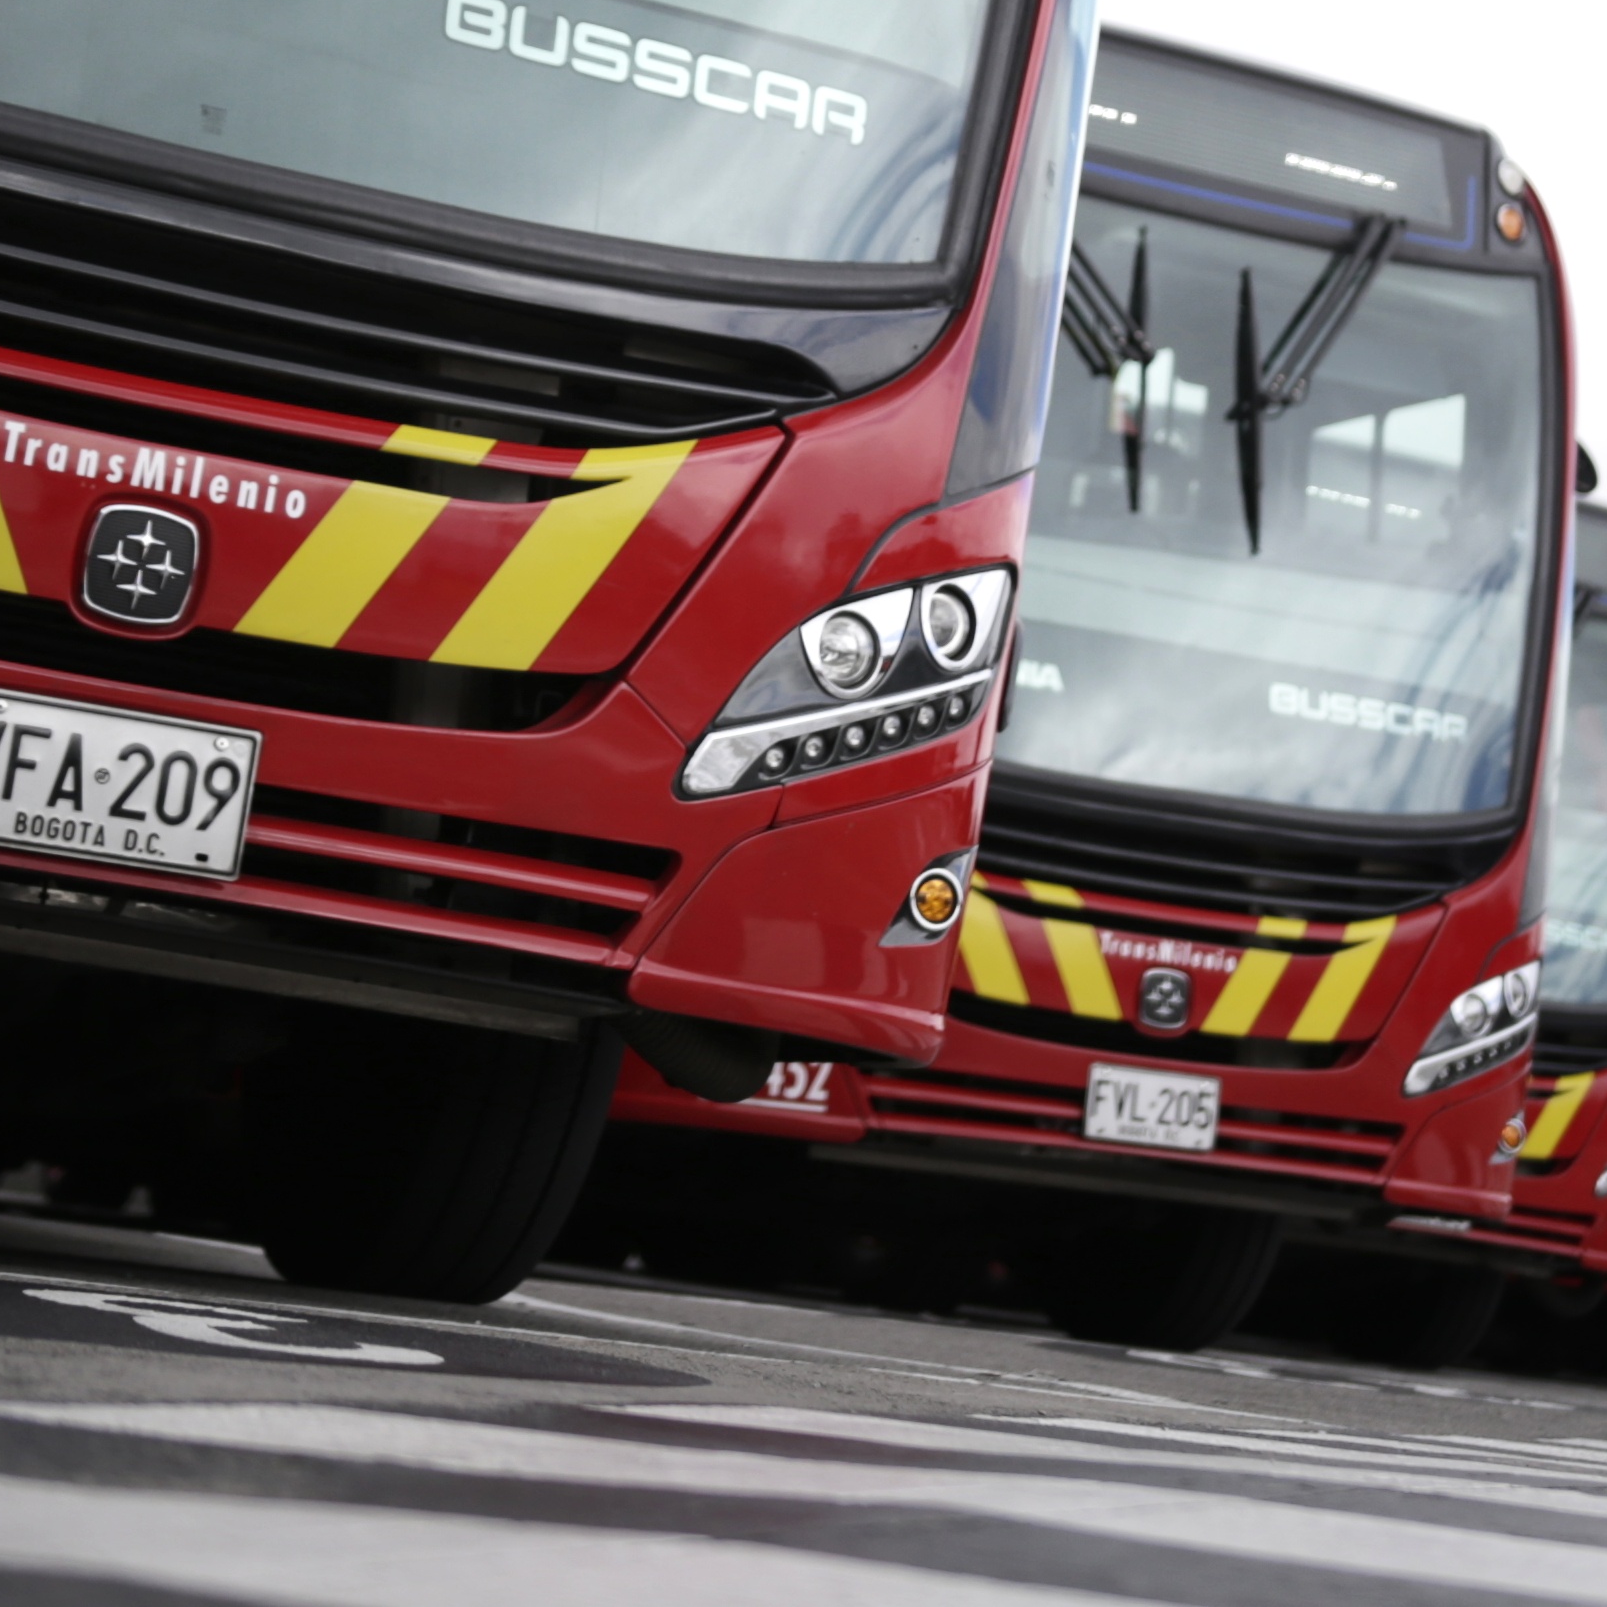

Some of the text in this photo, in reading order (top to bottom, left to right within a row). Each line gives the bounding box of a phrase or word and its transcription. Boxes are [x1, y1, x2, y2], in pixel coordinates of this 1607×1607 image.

[1, 420, 309, 521] TransMilenio
[1267, 681, 1470, 745] BUSSCAR
[13, 810, 167, 858] BOGOTA D.C.
[765, 1061, 831, 1101] 452
